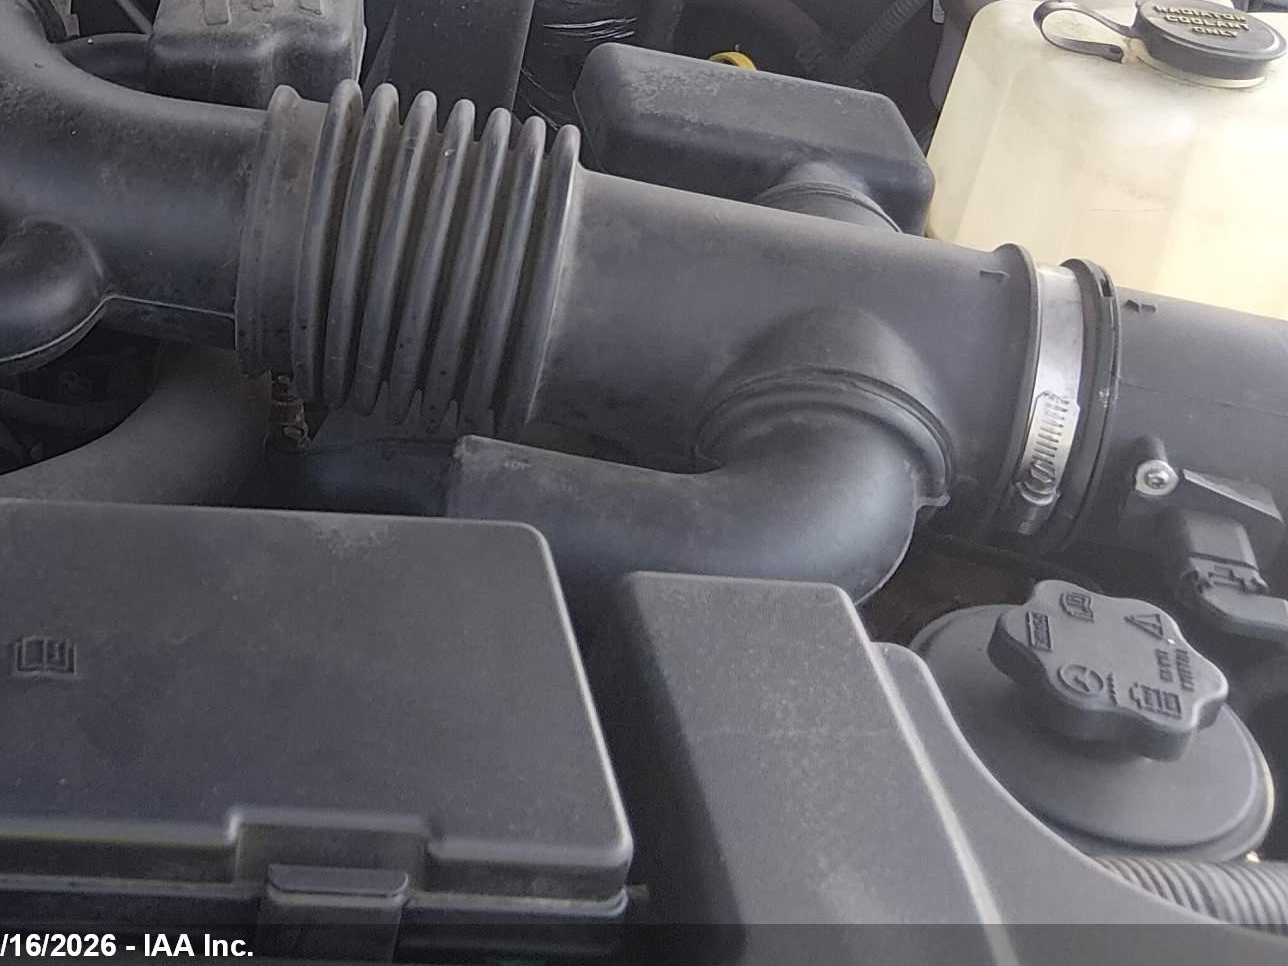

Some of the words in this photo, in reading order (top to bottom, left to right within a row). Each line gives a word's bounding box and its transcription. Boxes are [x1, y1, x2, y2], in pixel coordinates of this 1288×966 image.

[1152, 3, 1248, 23] RADIATOR
[1164, 14, 1250, 31] COOLANT
[1191, 26, 1240, 38] ONLY
